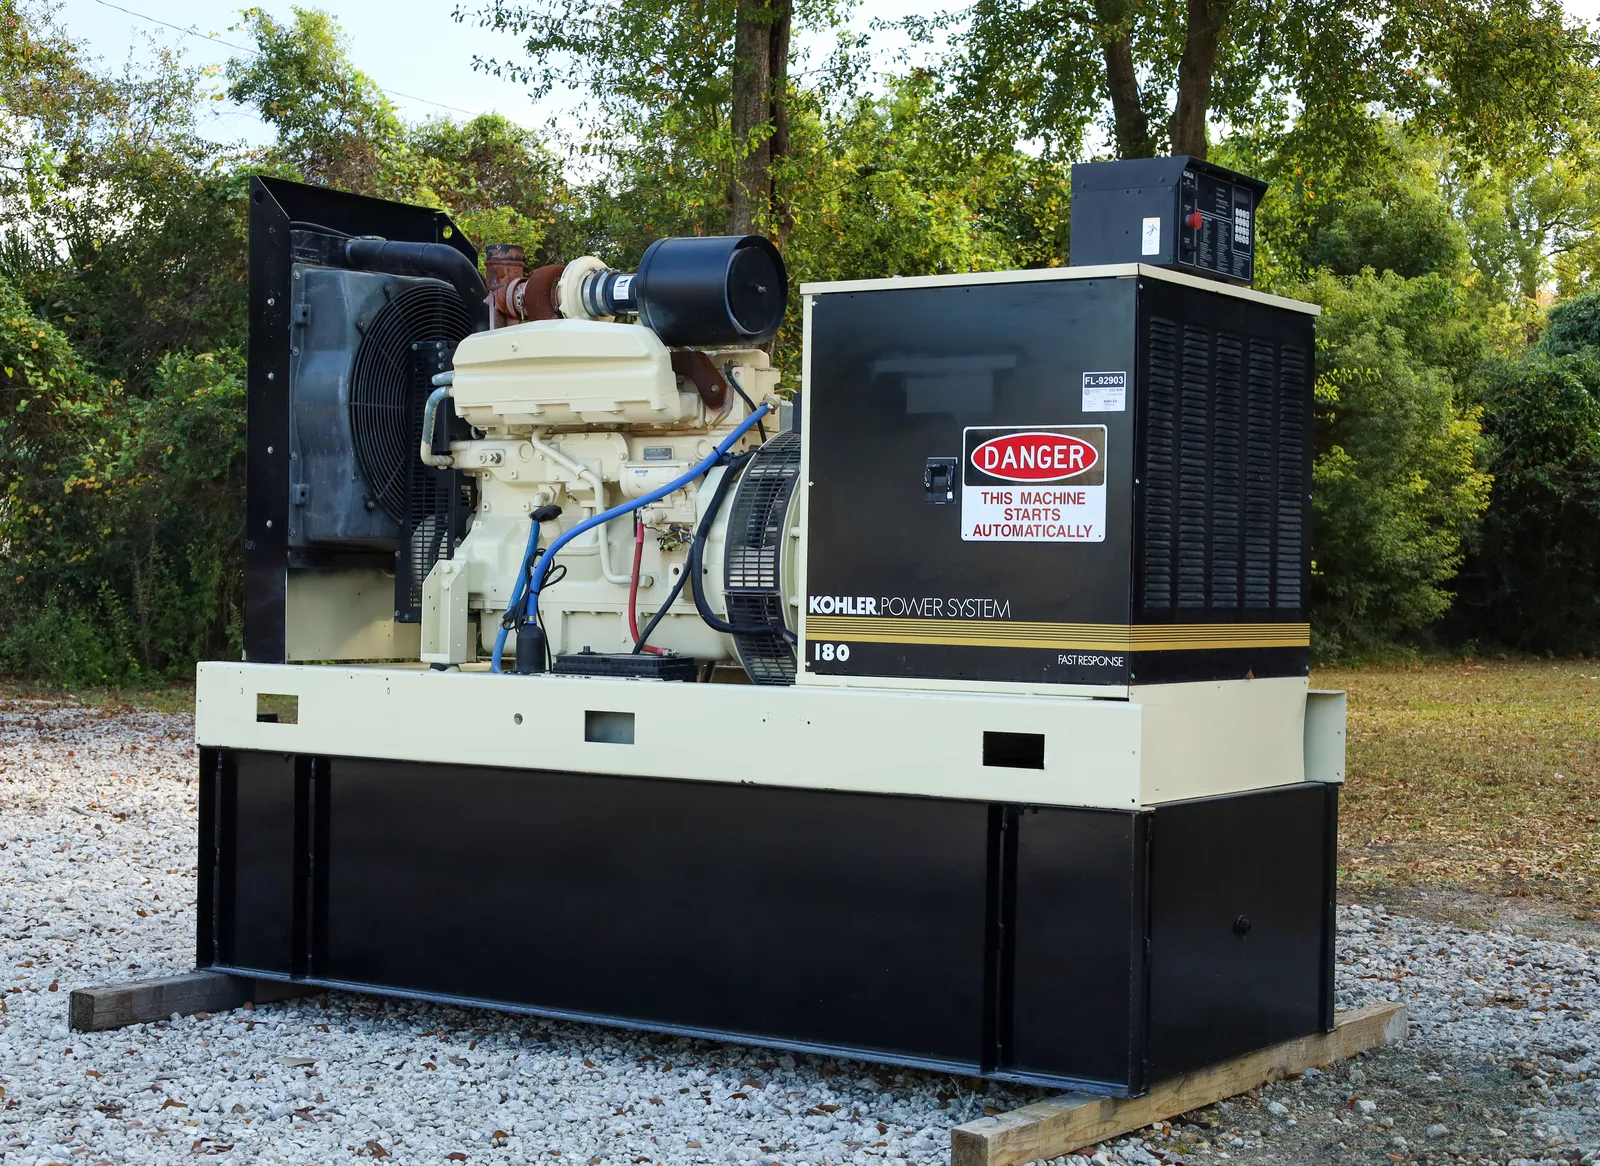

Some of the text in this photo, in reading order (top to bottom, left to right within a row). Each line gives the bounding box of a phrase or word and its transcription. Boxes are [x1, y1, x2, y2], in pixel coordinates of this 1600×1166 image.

[1085, 375, 1124, 386] FL-92903
[984, 445, 1085, 470] DANGER
[981, 492, 1086, 505] THIS MACHINE
[1004, 508, 1061, 521] STARTS
[972, 524, 1093, 538] AUTOMATICALLY
[881, 597, 943, 617] POWER
[947, 598, 1011, 618] SYSTEM
[814, 643, 850, 662] 180
[1057, 654, 1124, 667] FAST RESPONSE
